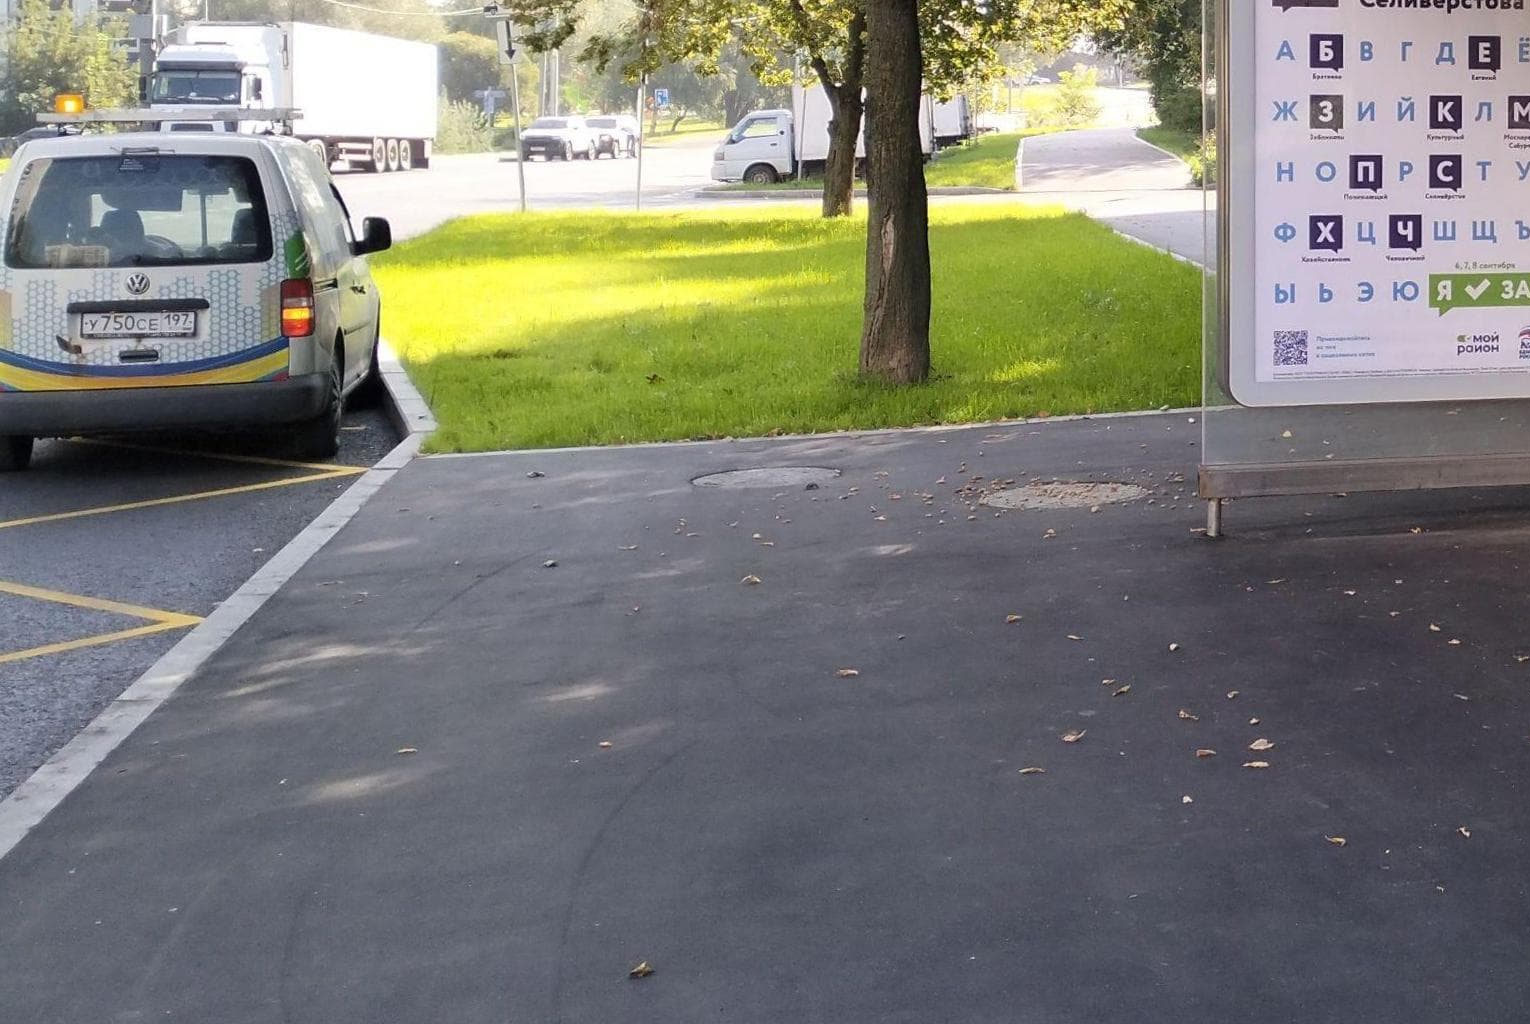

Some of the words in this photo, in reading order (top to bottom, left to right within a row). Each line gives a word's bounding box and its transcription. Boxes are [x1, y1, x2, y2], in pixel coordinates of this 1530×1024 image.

[1276, 40, 1295, 60] А
[1319, 40, 1334, 62] Б
[1360, 41, 1373, 61] В
[1401, 42, 1412, 61] Г
[1435, 42, 1455, 65] Д
[1478, 42, 1491, 63] Е
[1519, 37, 1530, 62] Ё
[1273, 101, 1298, 121] Ж
[1318, 101, 1334, 122] З
[1358, 101, 1375, 121] И
[1397, 97, 1415, 121] Й
[1437, 102, 1455, 122] К
[1475, 102, 1492, 121] Л
[1276, 162, 1294, 182] Н
[1315, 161, 1336, 182] О
[1357, 161, 1375, 182] П
[1400, 161, 1413, 181] Р
[1436, 161, 1453, 182] С
[1476, 161, 1491, 181] Т
[1274, 222, 1296, 243] Ф
[1316, 222, 1336, 243] Х
[1357, 222, 1376, 245] Ц
[1397, 221, 1413, 242] Ч
[1433, 221, 1456, 241] Ш
[1472, 220, 1497, 243] Щ
[1515, 220, 1530, 240] Ъ
[1275, 282, 1295, 304] Ы
[1319, 282, 1333, 303] Ь
[1357, 282, 1374, 302] Э
[1393, 281, 1419, 301] Ю
[1436, 280, 1451, 301] Я
[164, 314, 189, 326] 197
[1473, 332, 1499, 343] мой
